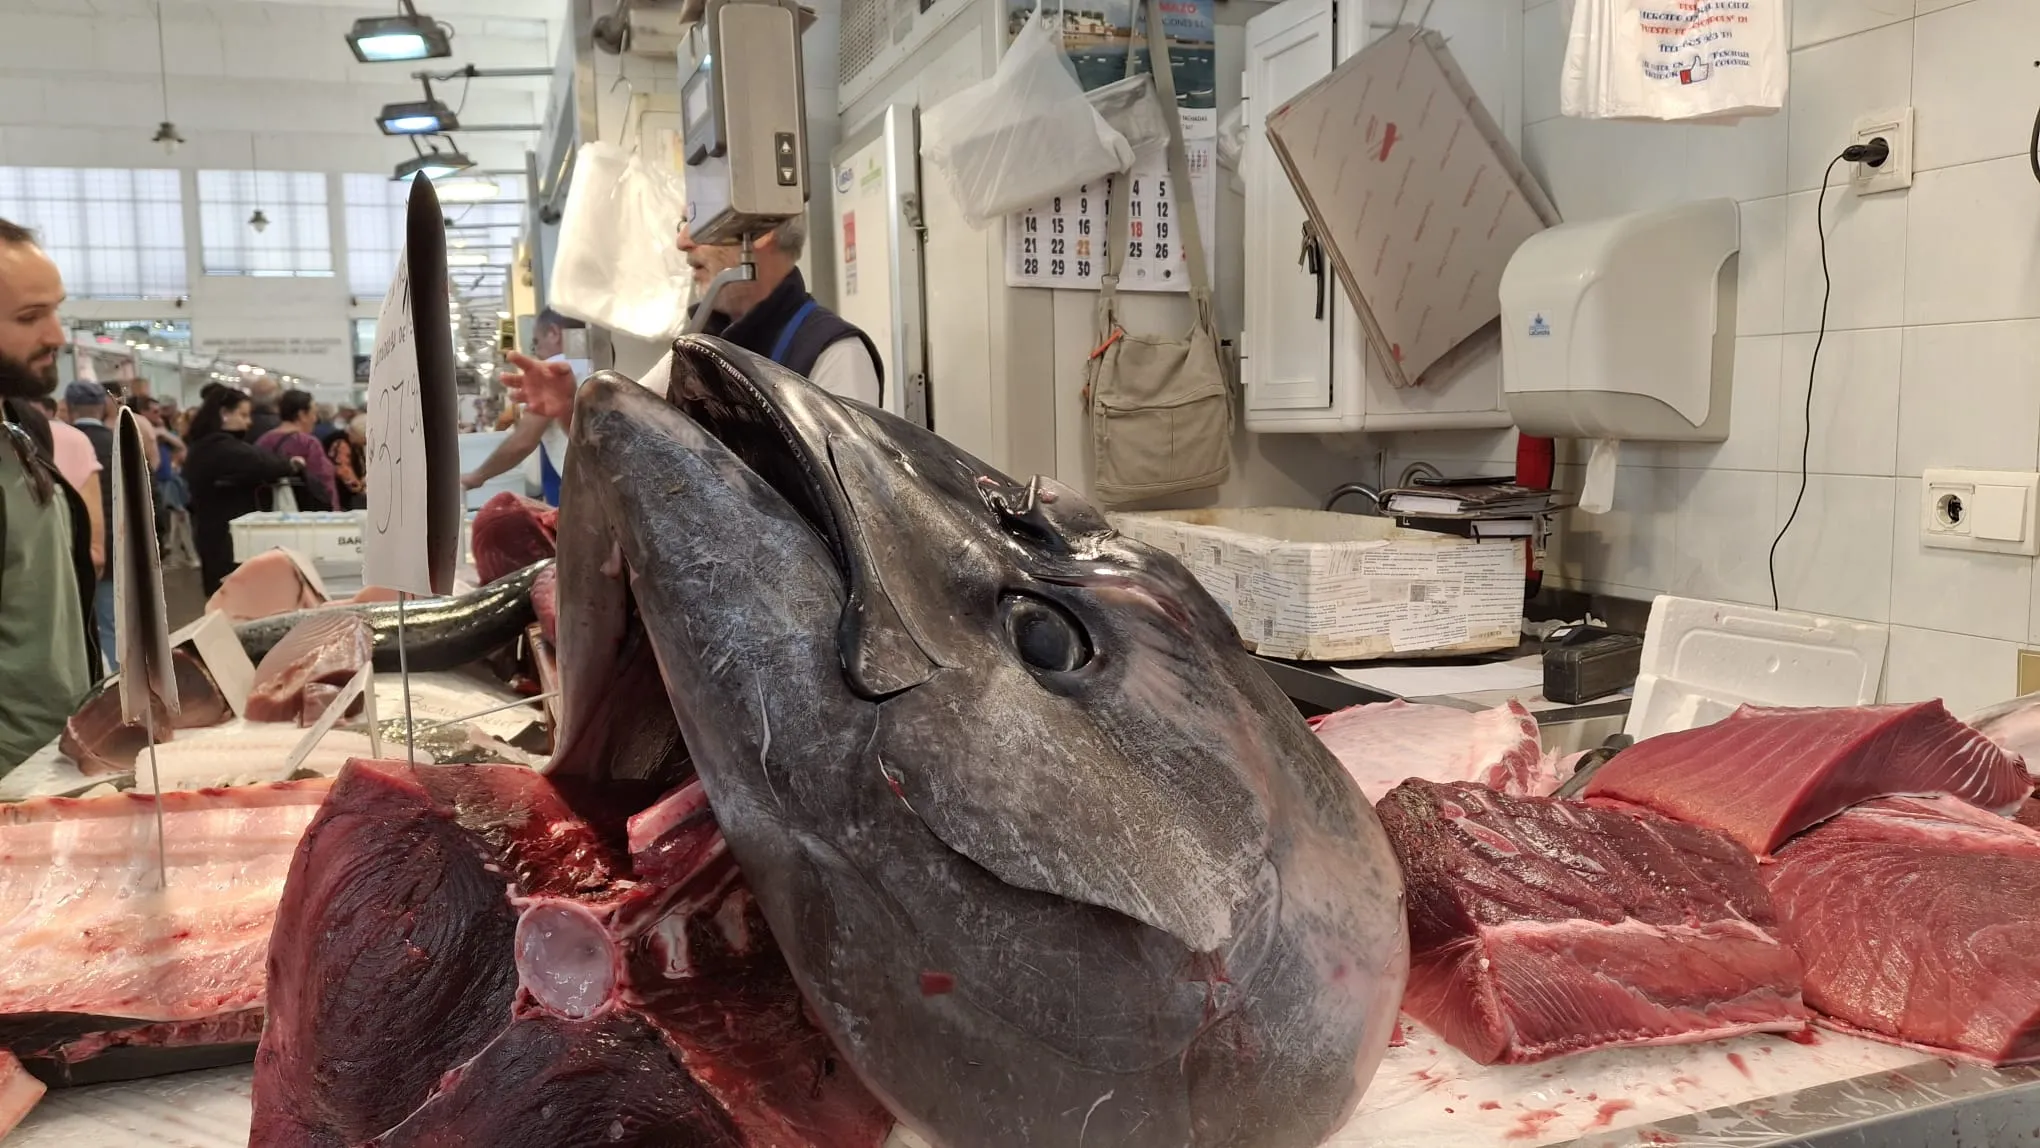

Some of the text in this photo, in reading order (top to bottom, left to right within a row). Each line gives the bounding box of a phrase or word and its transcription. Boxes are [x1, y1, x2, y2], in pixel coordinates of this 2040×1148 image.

[1133, 180, 1140, 195] 4
[1159, 181, 1166, 197] 5
[1054, 197, 1061, 213] 8
[1081, 198, 1088, 214] 9
[1131, 201, 1142, 216] 11
[1157, 202, 1169, 217] 12
[1025, 216, 1169, 238] 14 15 16 18 19
[1024, 238, 1037, 253] 21
[1052, 239, 1065, 254] 22
[1129, 242, 1142, 257] 25
[1156, 243, 1169, 258] 26
[1024, 258, 1090, 276] 28 29 30
